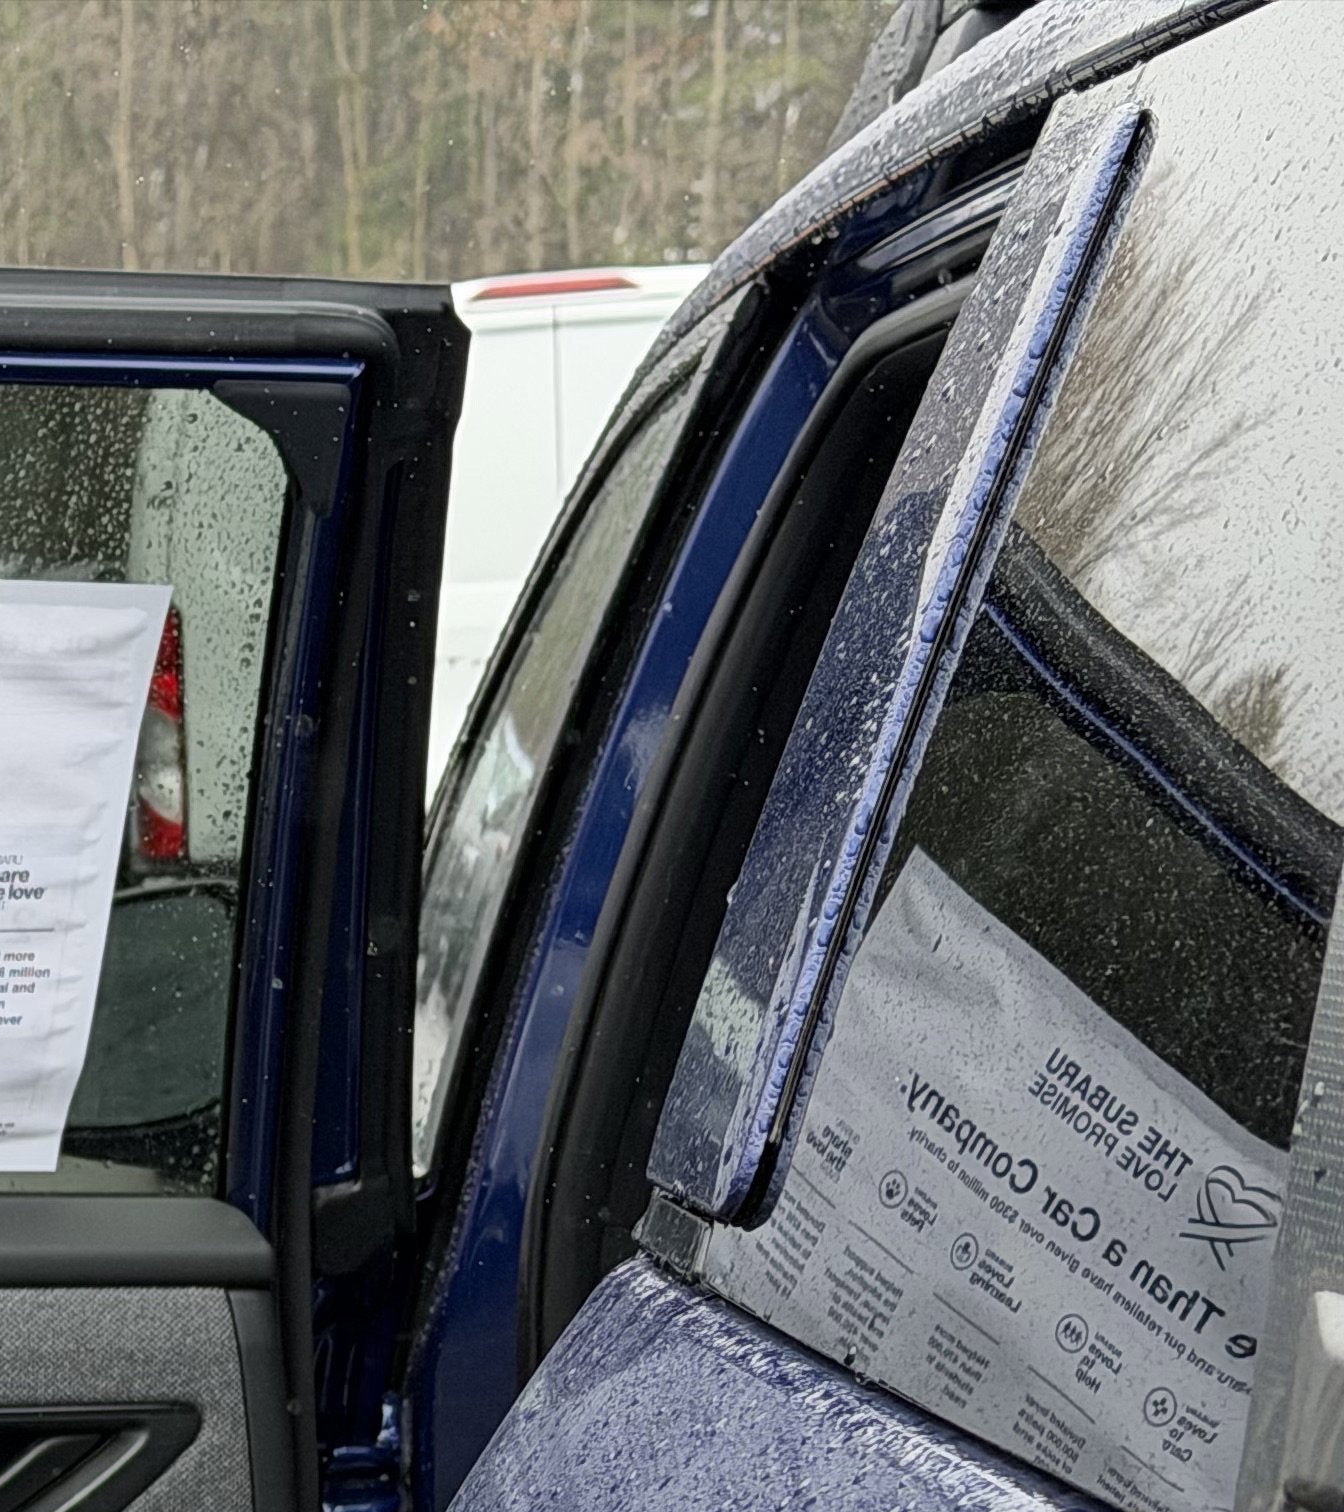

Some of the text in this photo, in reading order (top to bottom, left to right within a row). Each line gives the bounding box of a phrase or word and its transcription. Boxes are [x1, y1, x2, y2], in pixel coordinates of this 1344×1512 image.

[8, 885, 45, 900] love
[3, 953, 35, 961] more
[9, 967, 50, 978] million
[12, 982, 35, 993] and
